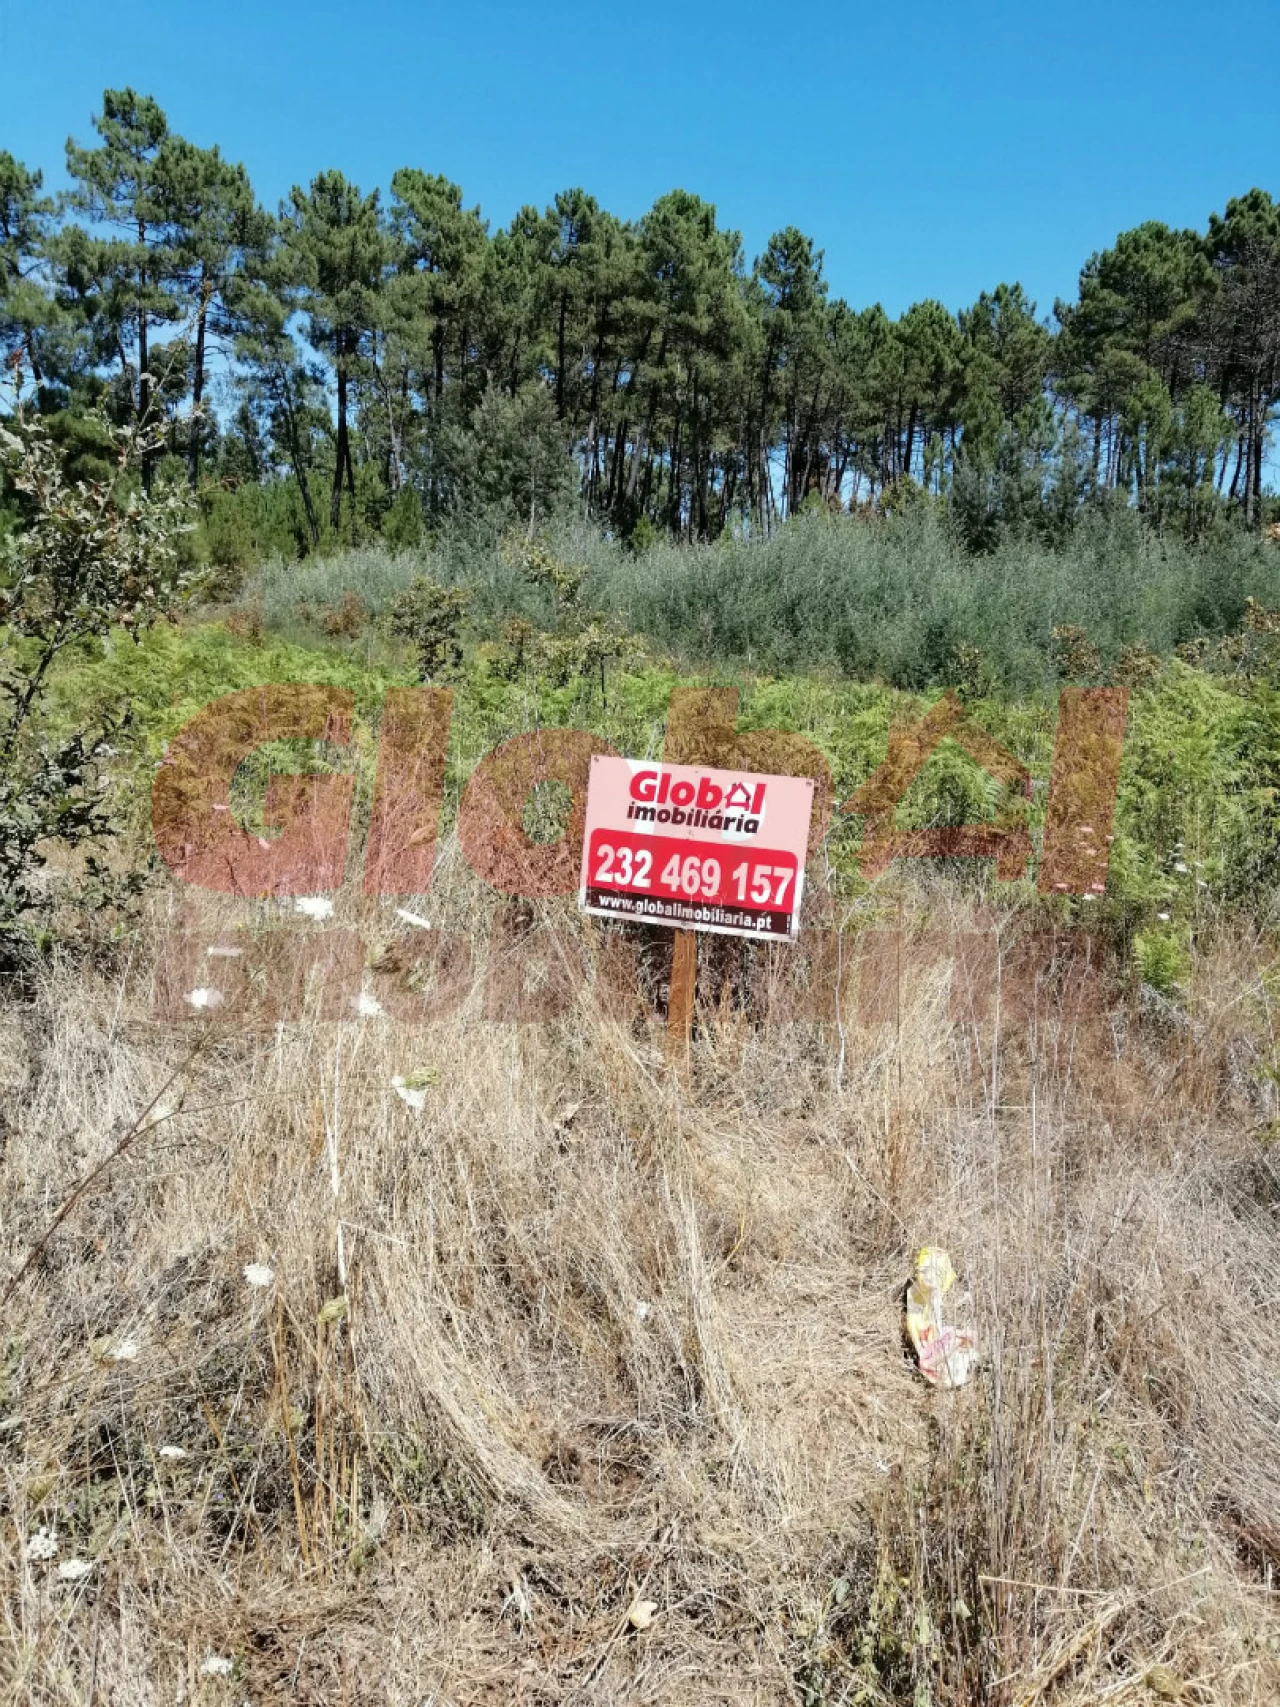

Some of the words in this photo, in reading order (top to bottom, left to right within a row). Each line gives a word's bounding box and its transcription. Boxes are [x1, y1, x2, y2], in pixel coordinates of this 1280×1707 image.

[626, 800, 760, 834] imobiliária
[594, 844, 653, 888] 232
[660, 853, 722, 897] 469
[732, 862, 794, 906] 157
[598, 893, 772, 931] www.globalimobiliaria.pt
